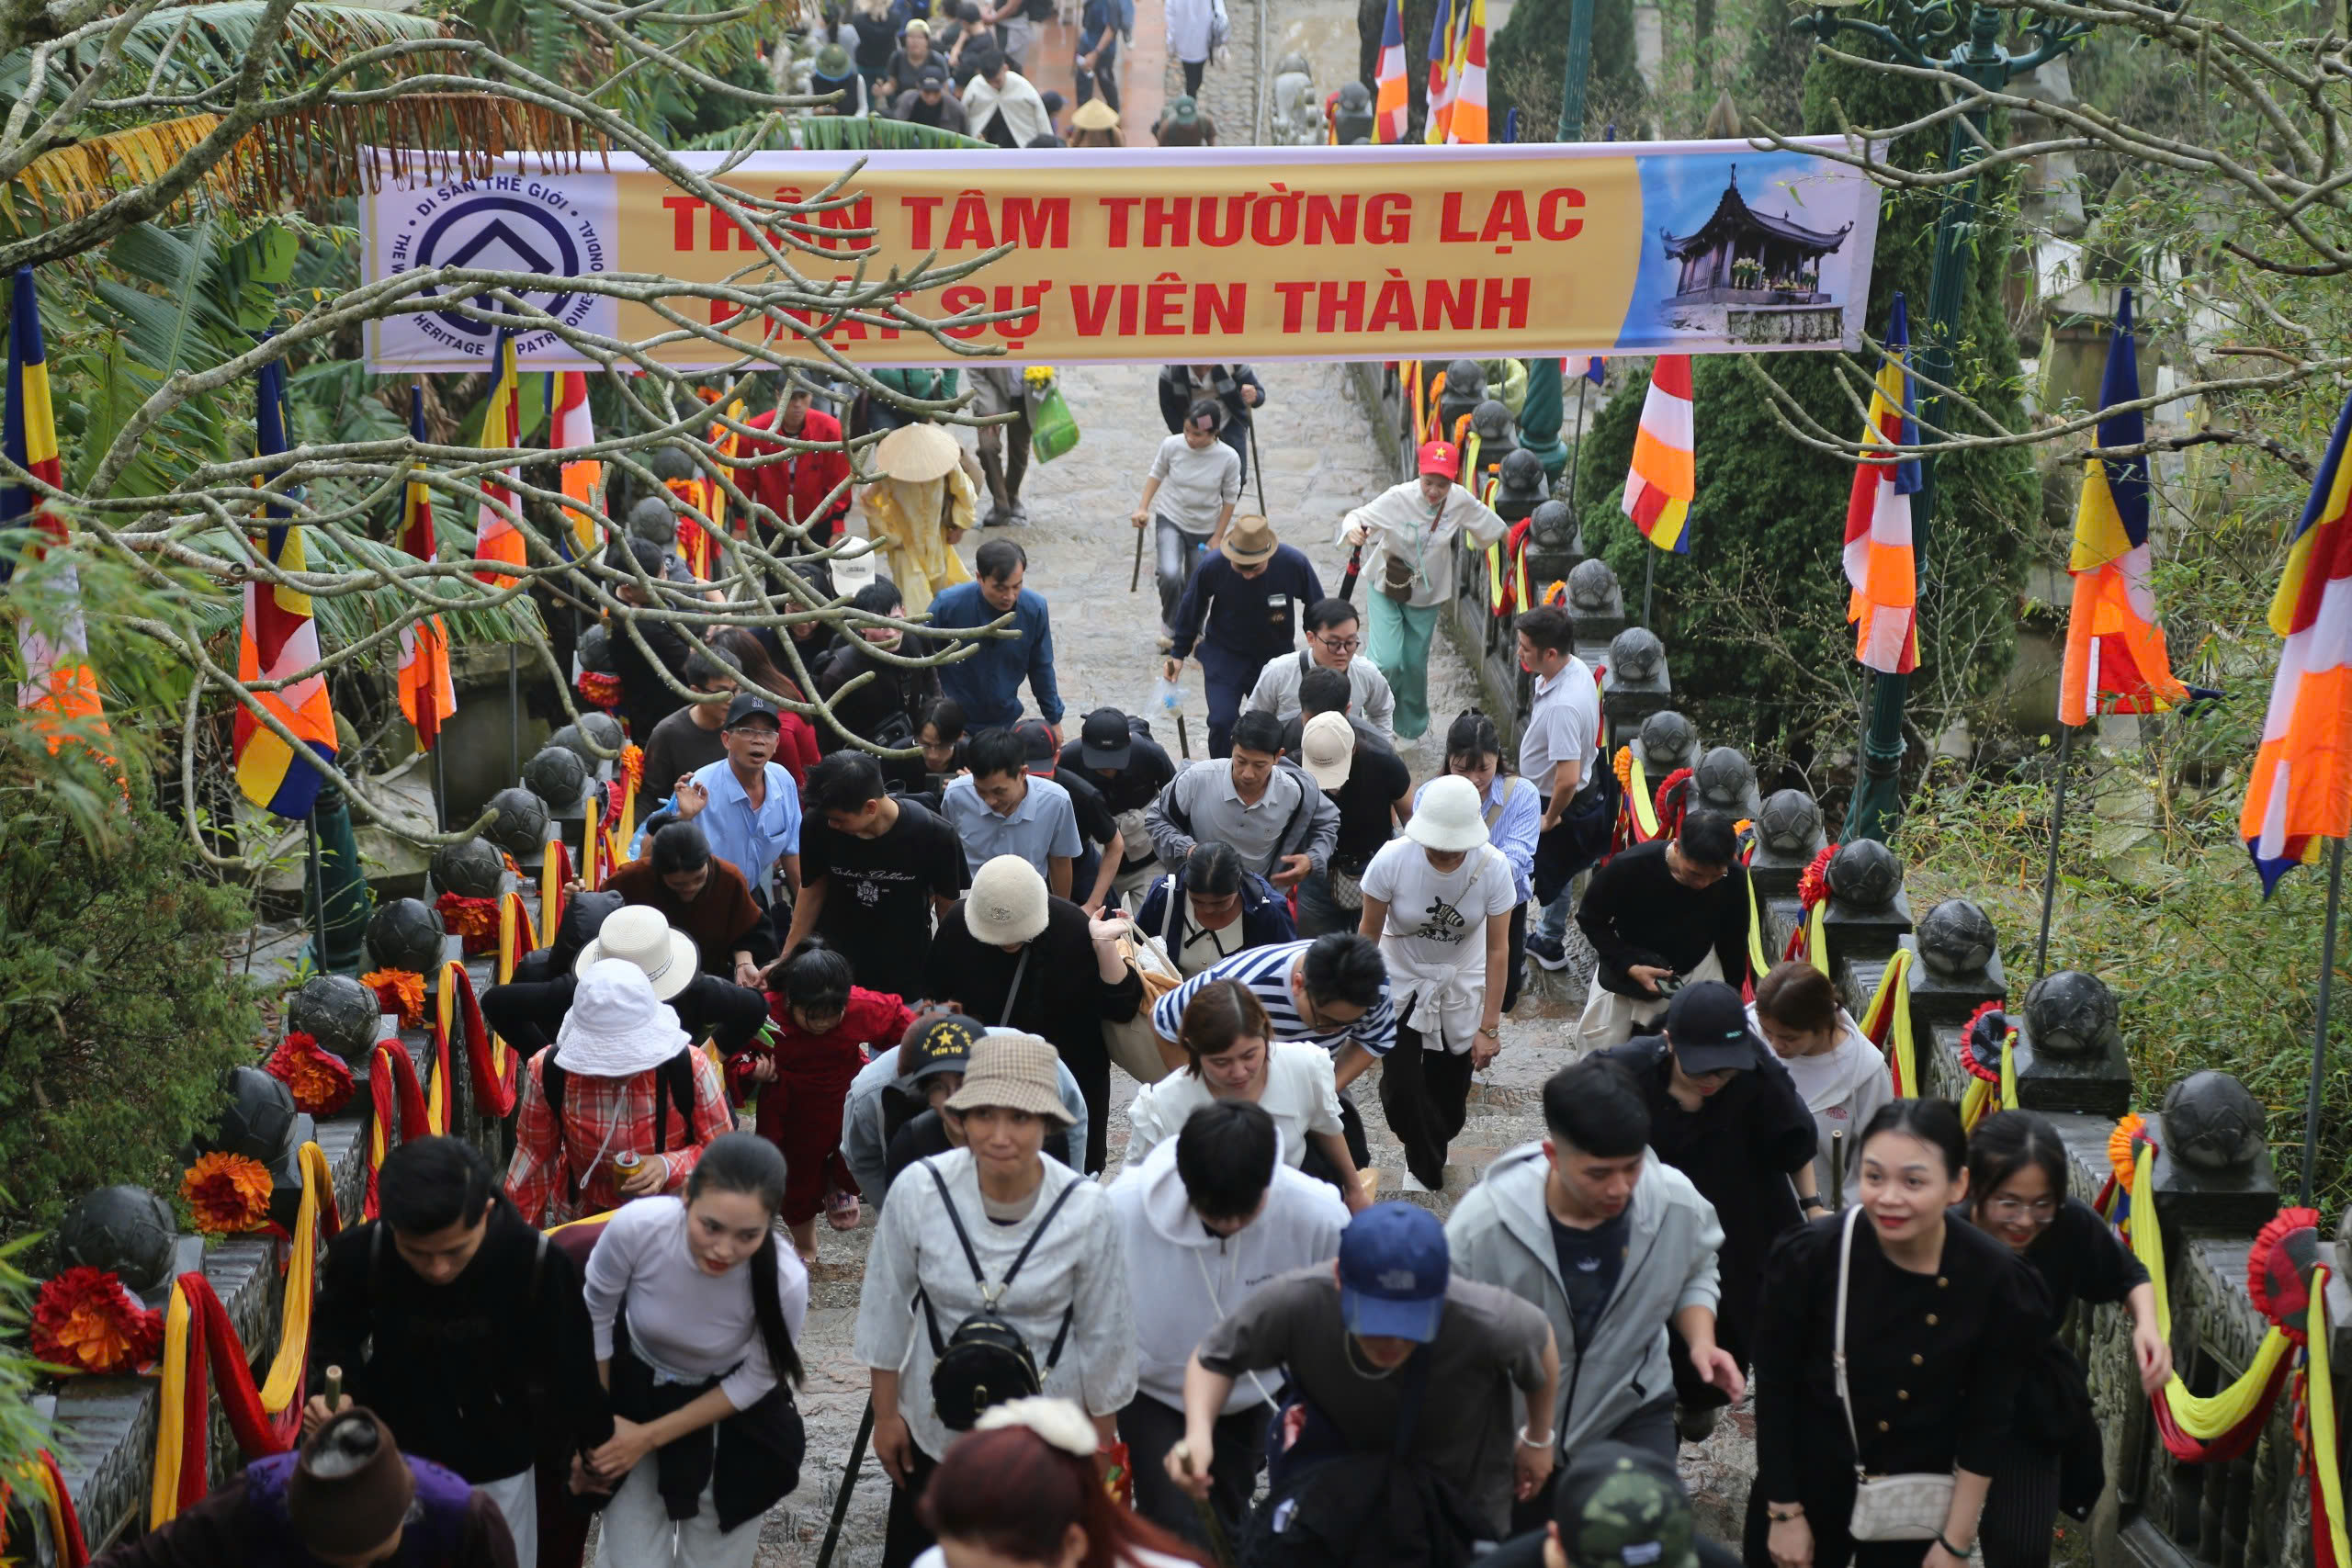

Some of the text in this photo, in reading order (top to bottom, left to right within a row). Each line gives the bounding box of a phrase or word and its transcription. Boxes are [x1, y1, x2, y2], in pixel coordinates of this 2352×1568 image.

[416, 197, 438, 217] DI
[528, 183, 569, 209] GIỚI
[901, 189, 1070, 250] TÂM
[1100, 183, 1412, 248] THƯỜNG
[1440, 188, 1586, 254] LẠC
[391, 234, 485, 355] THE HERITAGE
[516, 220, 604, 355] PATROINE ONDIAL
[941, 280, 1052, 349] SỰ
[1069, 272, 1247, 336] VIÊN
[1274, 268, 1531, 333] THÀNH
